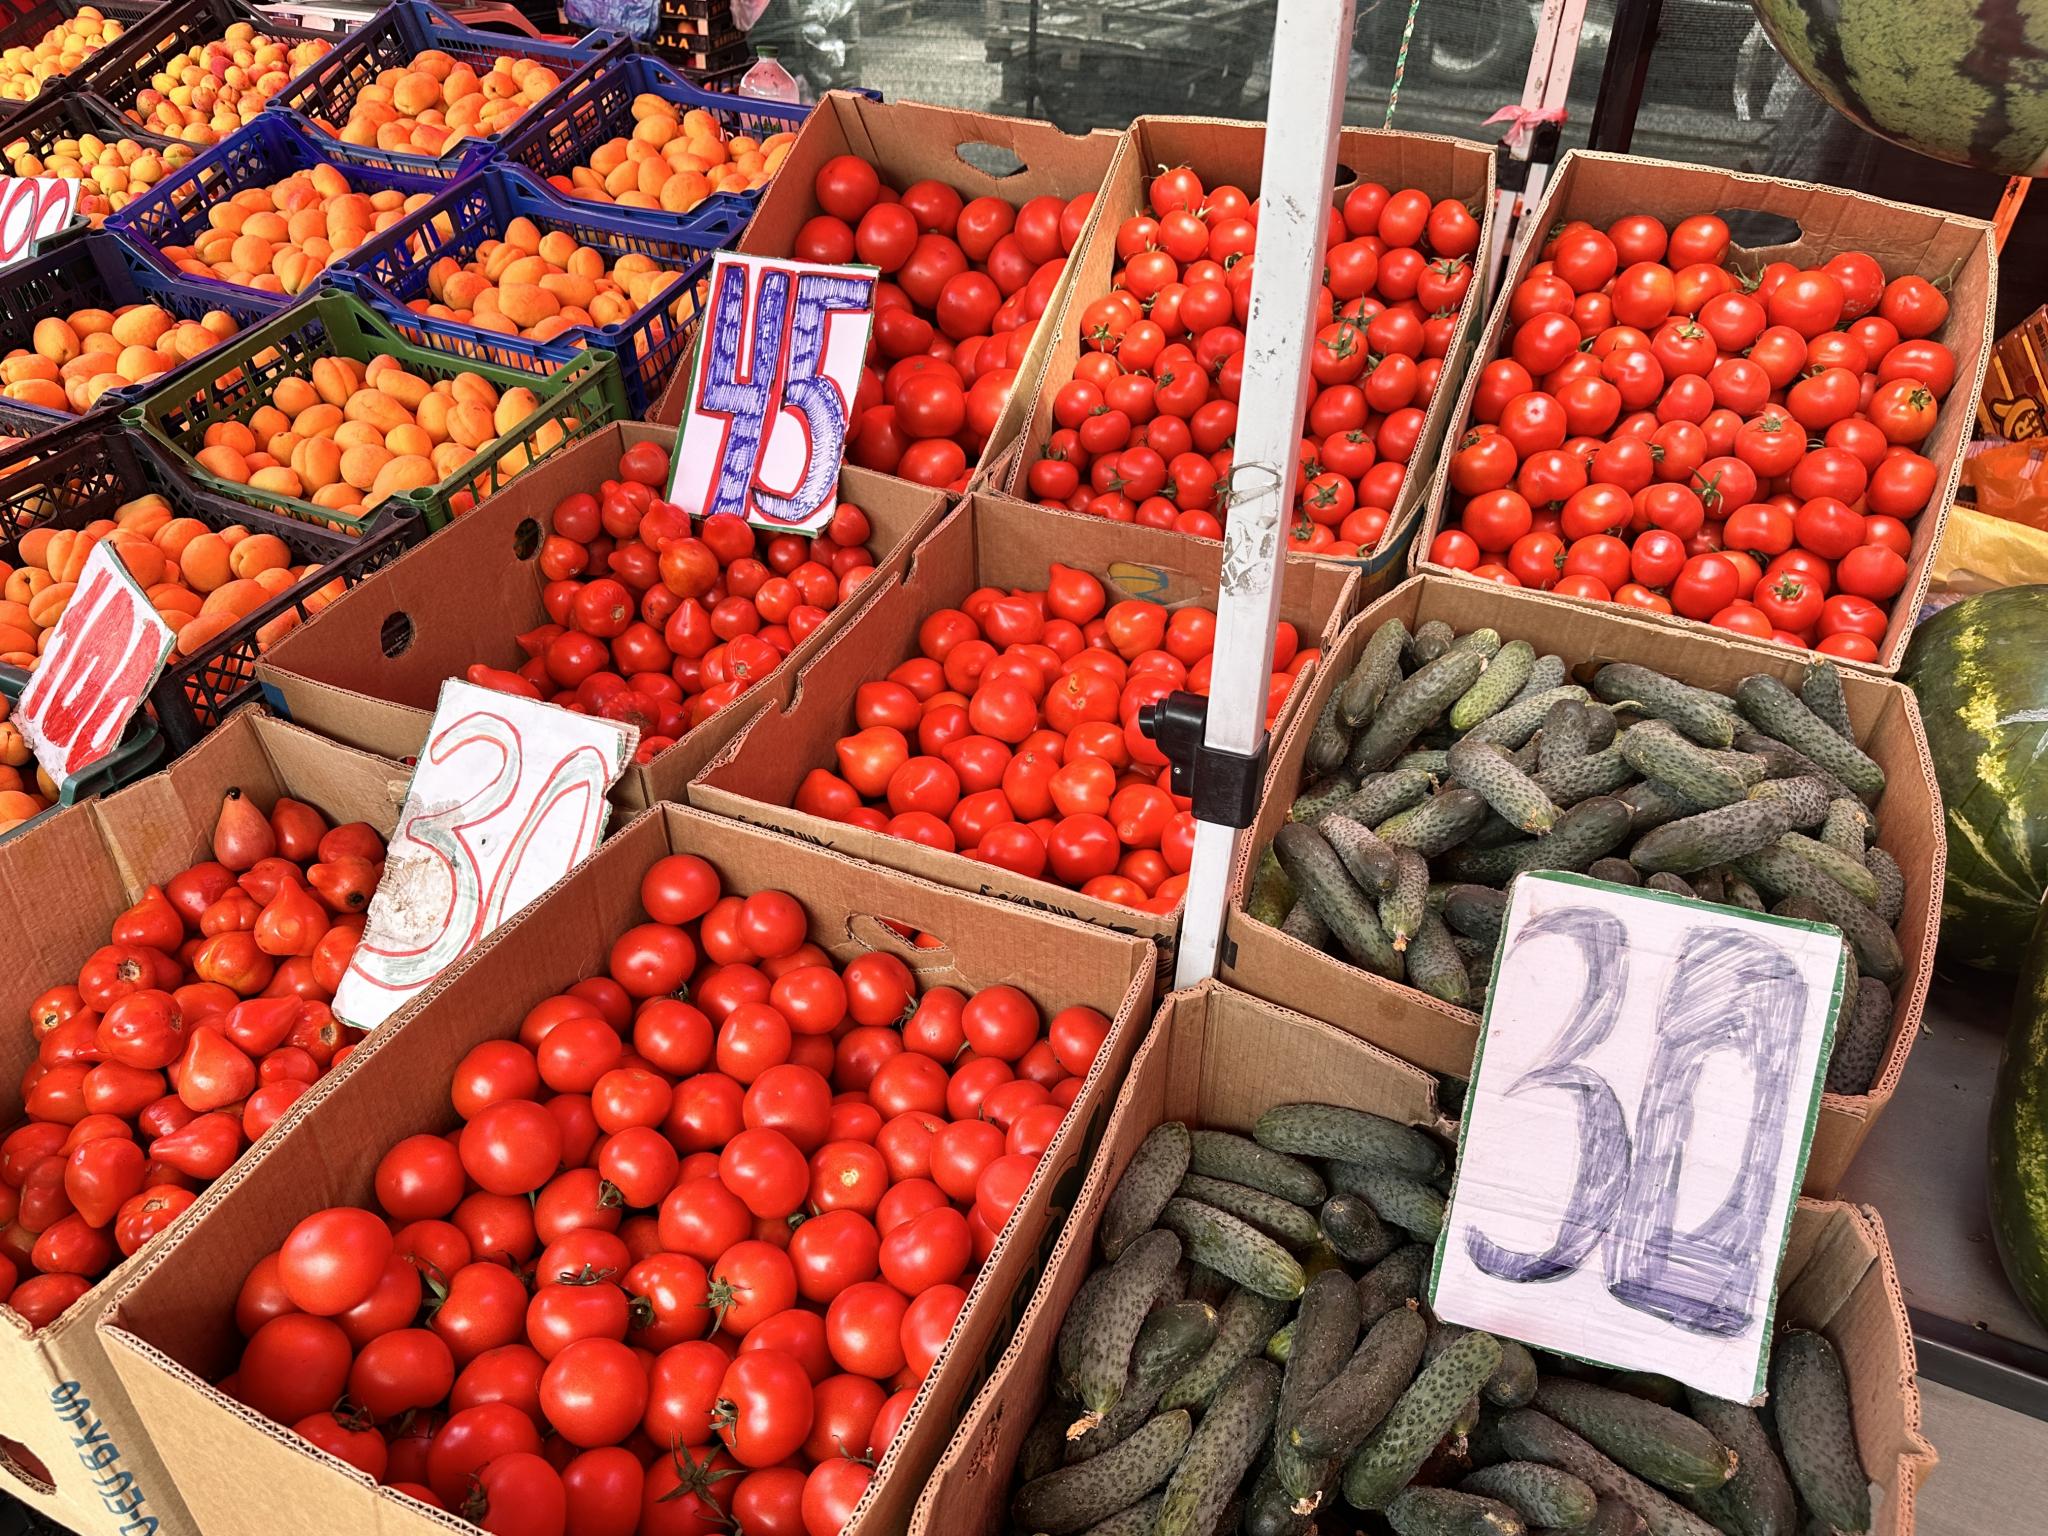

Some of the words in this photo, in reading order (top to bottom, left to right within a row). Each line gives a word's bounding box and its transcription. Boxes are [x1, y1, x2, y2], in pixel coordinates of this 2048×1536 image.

[696, 262, 877, 524] 45
[350, 711, 610, 990] 30
[1464, 905, 1809, 1340] 30
